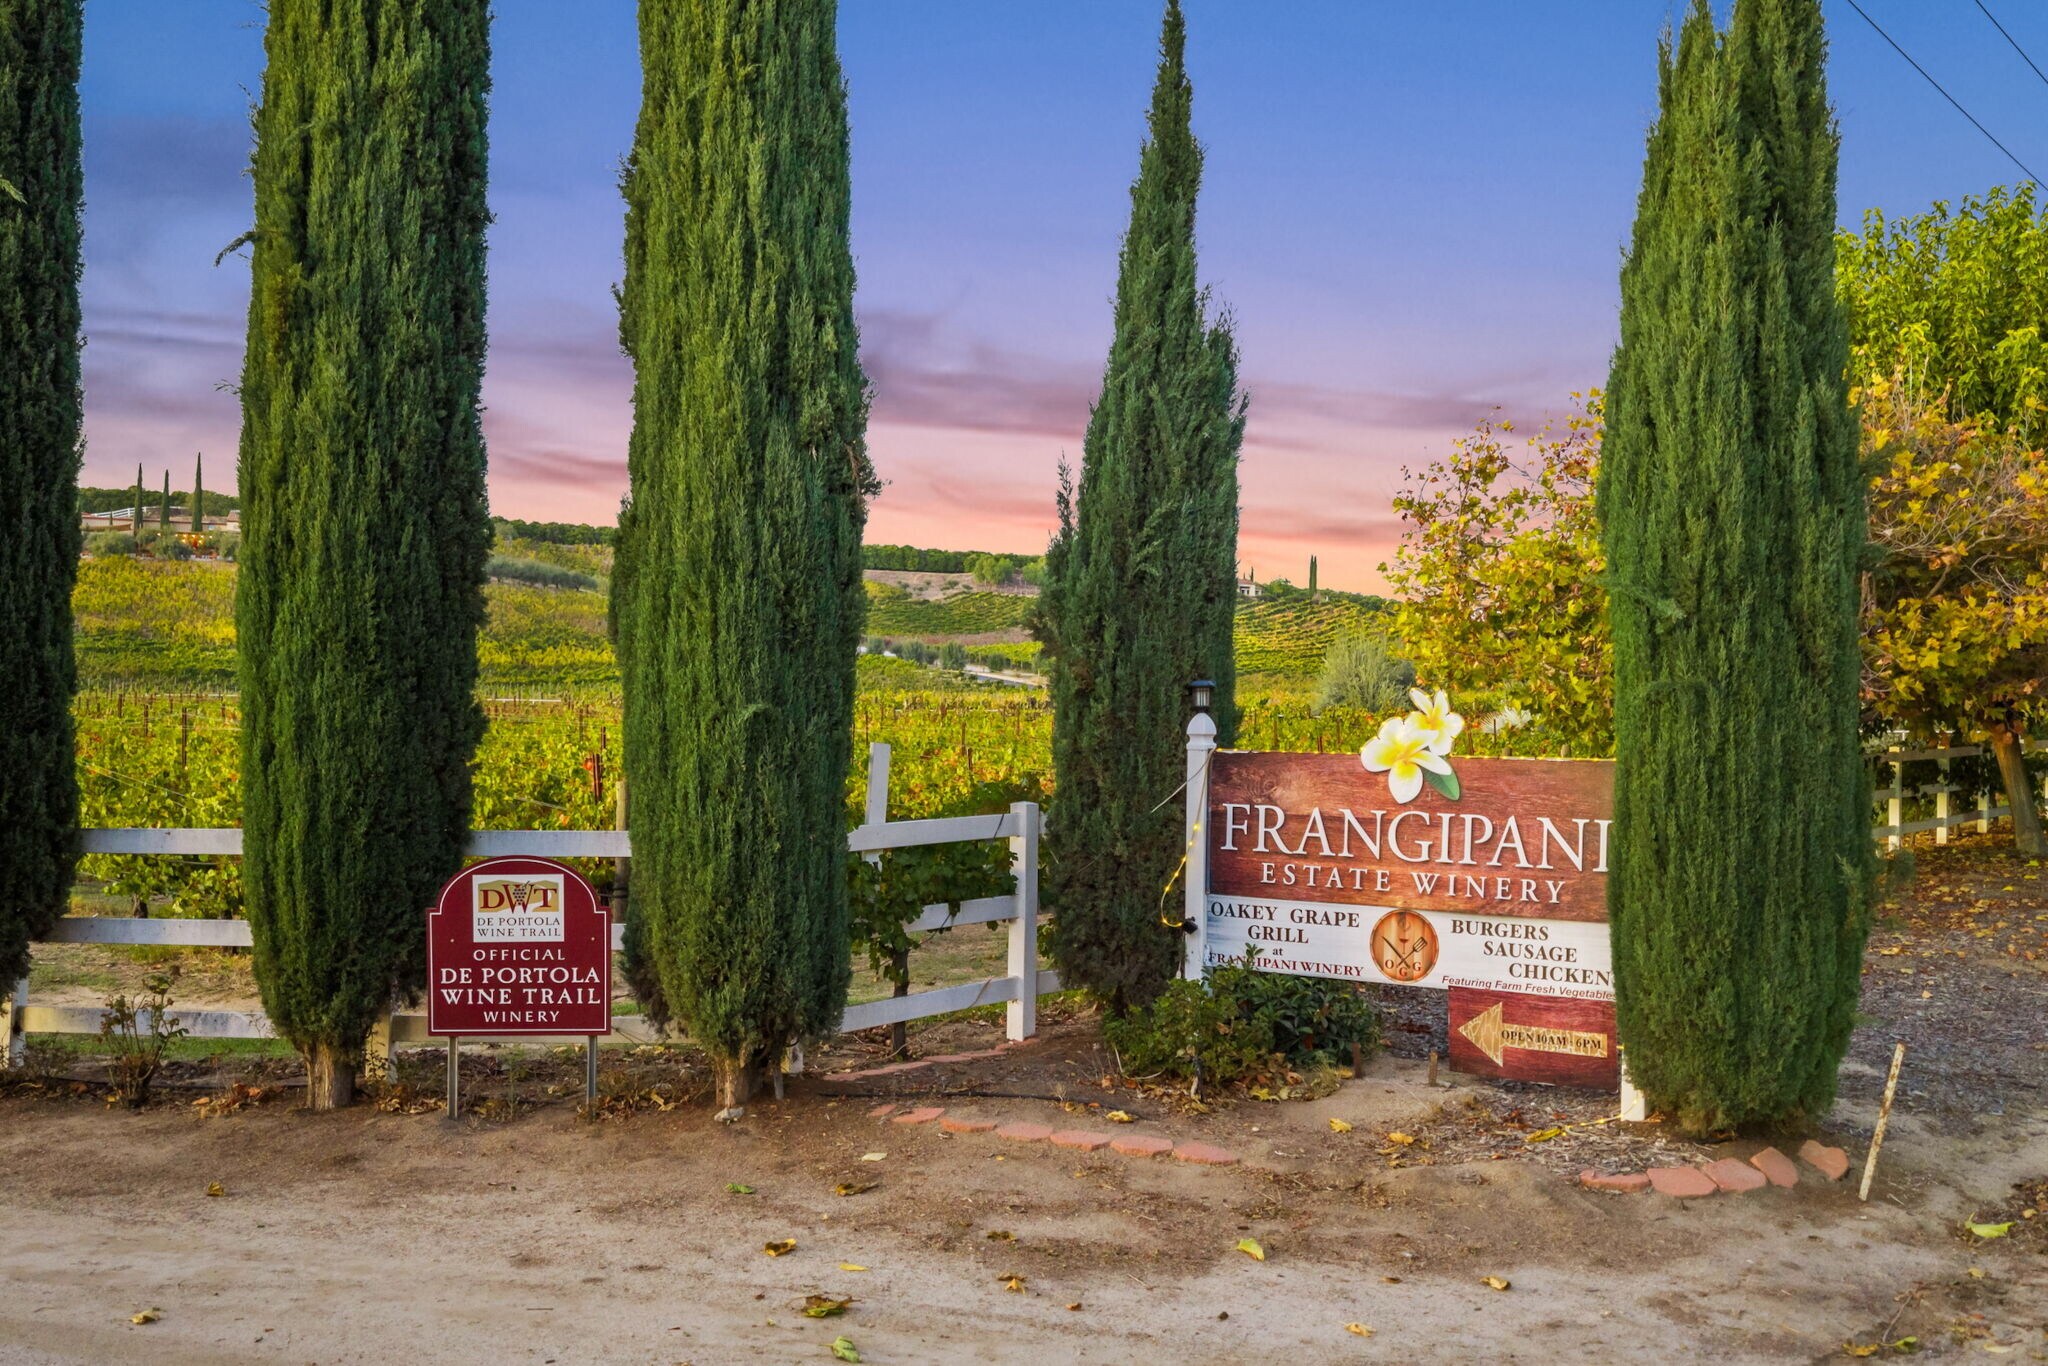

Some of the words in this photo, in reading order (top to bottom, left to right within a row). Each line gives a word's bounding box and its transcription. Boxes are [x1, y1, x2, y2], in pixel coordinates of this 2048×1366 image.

[1220, 803, 1613, 873] FRANGIPANI
[1260, 862, 1391, 892] ESTATE
[1410, 872, 1566, 904] WINERY
[480, 883, 557, 914] DWT
[477, 917, 493, 926] DE
[499, 917, 560, 926] PORTOLA
[1210, 901, 1278, 921] OAKEY
[1290, 908, 1360, 928] GRAPE
[477, 928, 515, 937] WINE
[519, 928, 561, 937] TRAIL
[1247, 924, 1309, 944] GRILL
[1451, 919, 1549, 941] BURGERS
[473, 949, 566, 961] OFFICIAL
[1272, 948, 1283, 956] at
[1483, 940, 1577, 963] SAUSAGE
[440, 967, 472, 984] DE
[482, 967, 600, 984] PORTOLA
[1300, 961, 1364, 977] WINERY
[1442, 975, 1492, 989] Featuring
[1495, 980, 1522, 991] Farm
[1525, 983, 1556, 995] Fresh
[440, 988, 512, 1005] WINE
[523, 988, 601, 1005] TRAIL
[484, 1011, 560, 1023] WINERY
[1501, 1029, 1534, 1042] OPEN
[1536, 1034, 1567, 1046] 10AM
[1576, 1039, 1601, 1050] 6PM
